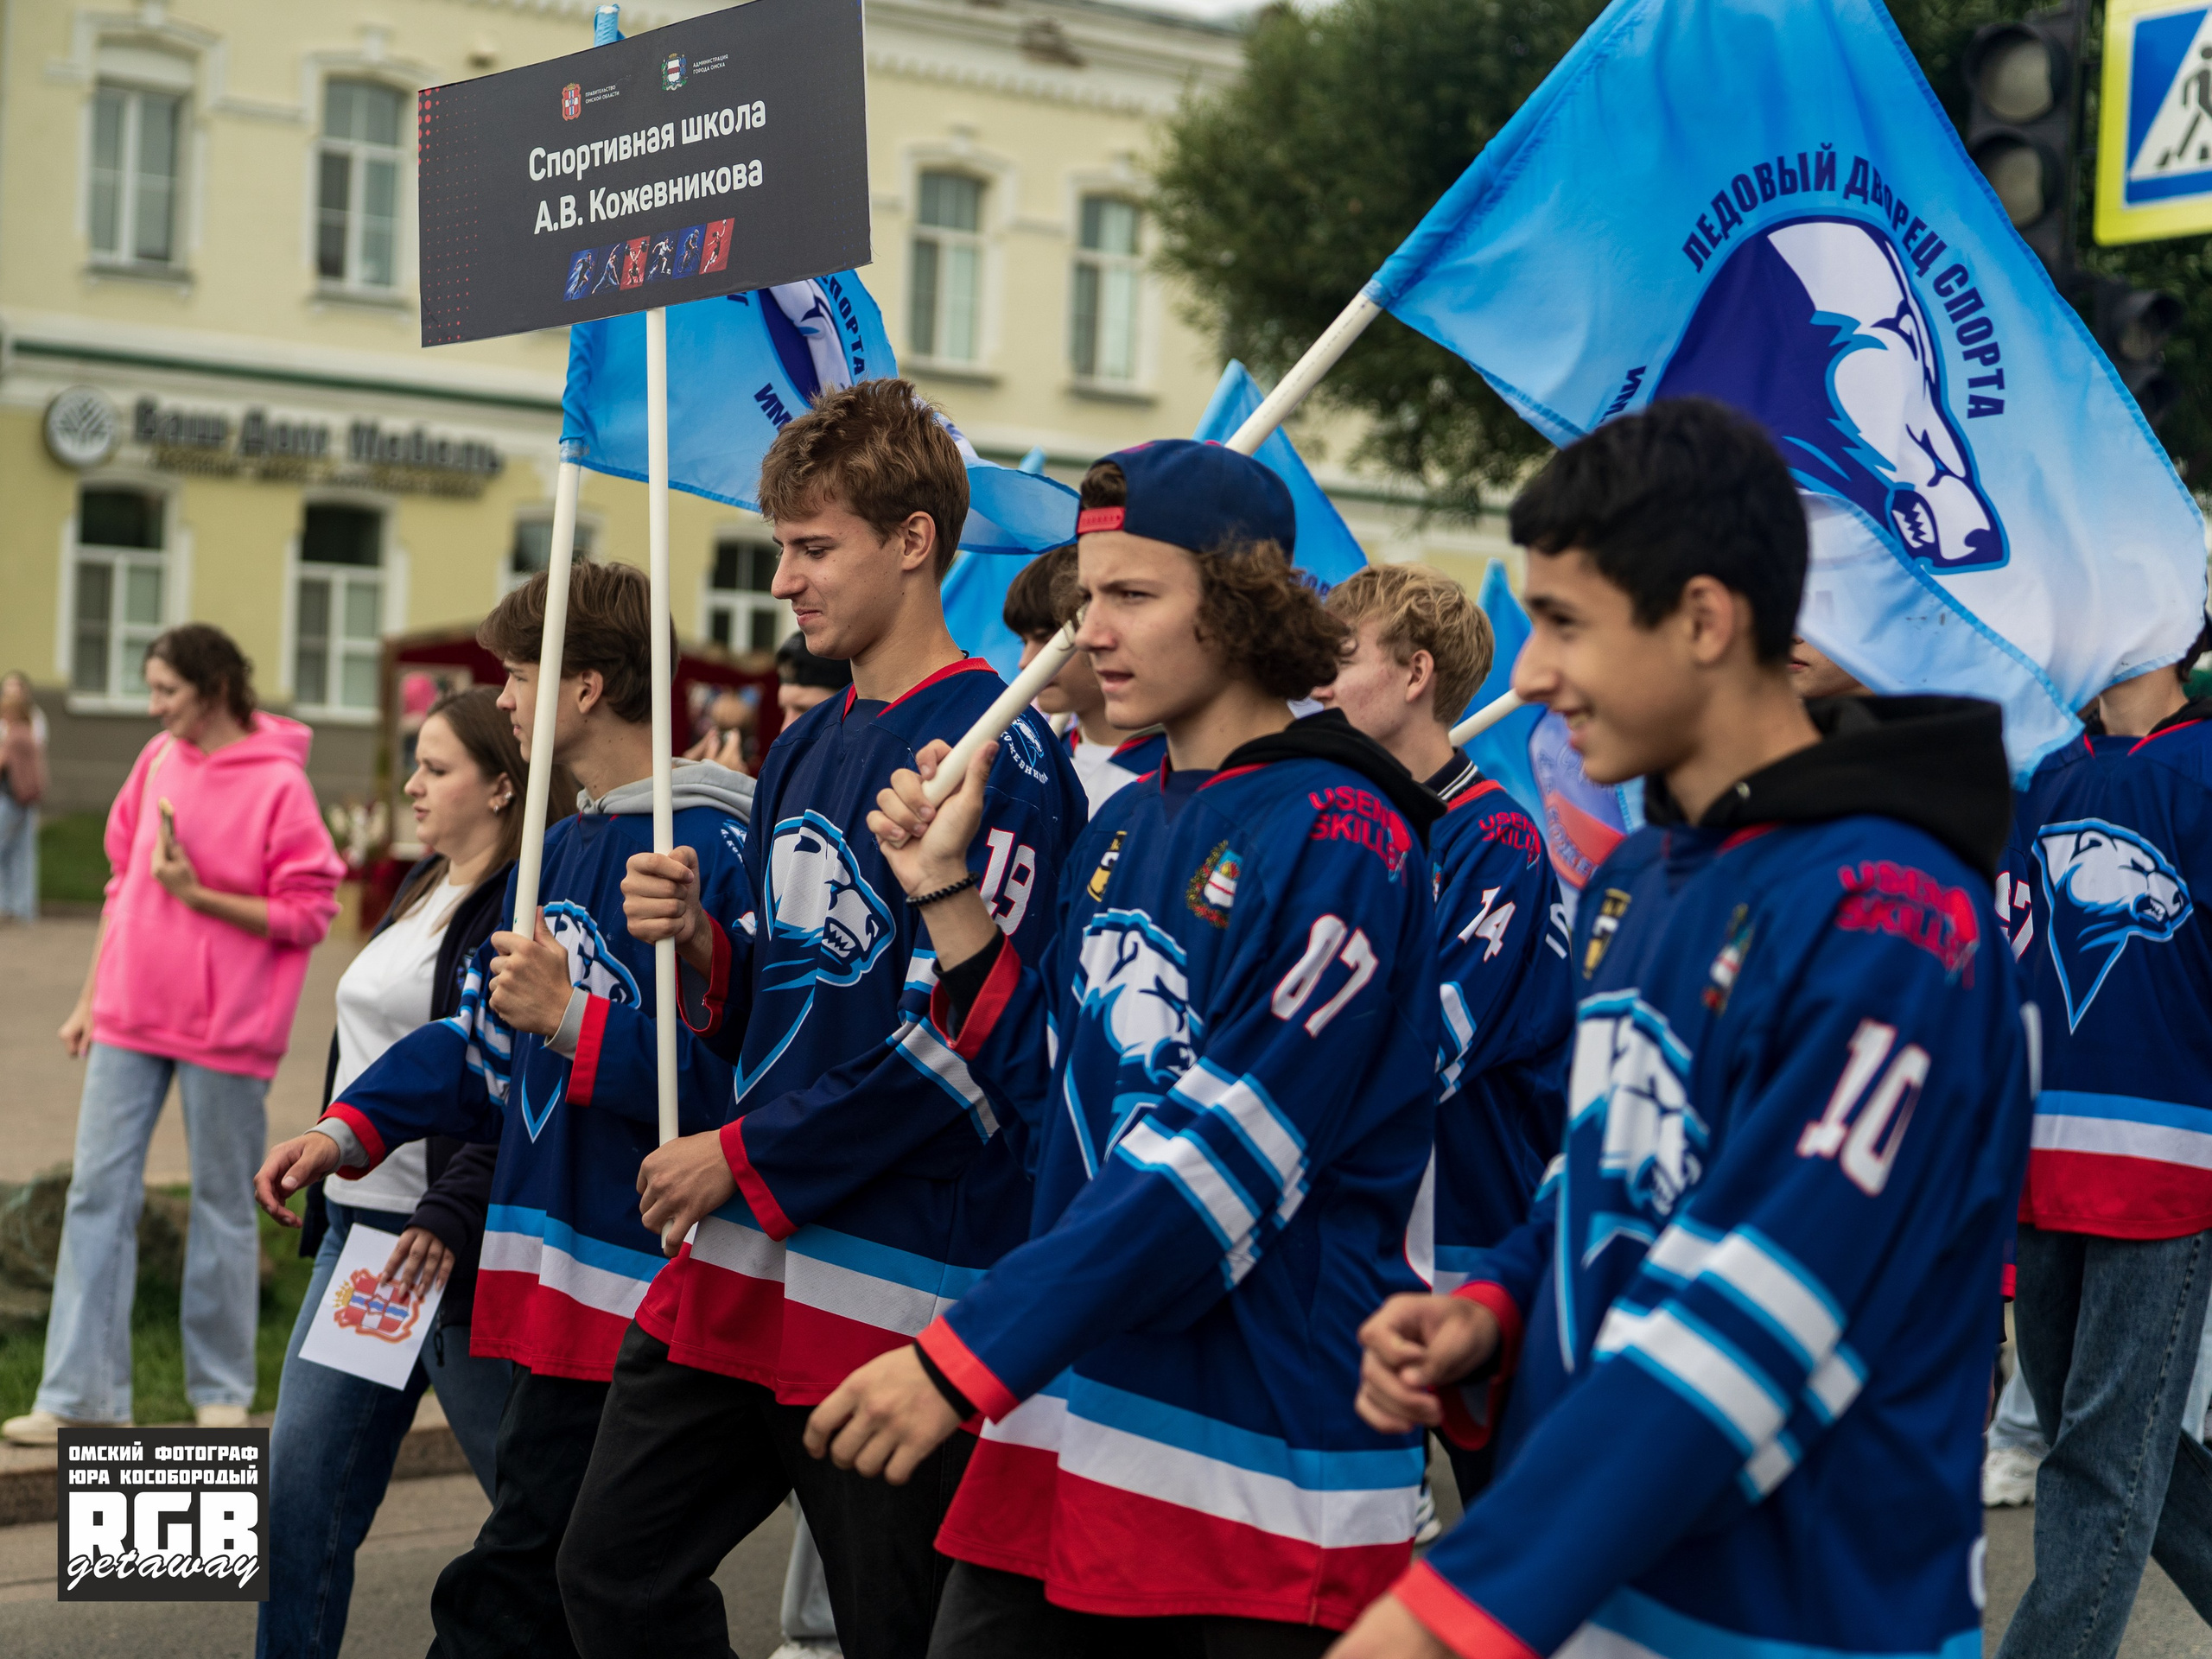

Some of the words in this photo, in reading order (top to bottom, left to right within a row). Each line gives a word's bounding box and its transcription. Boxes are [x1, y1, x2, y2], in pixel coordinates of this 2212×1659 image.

[585, 85, 616, 97] ПРАВИТЕЛЬСТВО
[585, 94, 602, 104] ОМСКОЙ
[602, 91, 620, 99] ОБЛАСТИ
[692, 54, 728, 68] АДМИНИСТРАЦИЯ
[710, 62, 726, 71] ОМСКА
[529, 122, 675, 181] Спортивная
[681, 100, 766, 145] школа
[534, 194, 583, 235] А.В.
[589, 159, 763, 223] Кожевникова
[1681, 142, 1836, 273] ЛЕДОВЫЙ
[1843, 156, 1948, 277] ДВОРЕЦ
[1933, 263, 2005, 419] СПОРТА
[980, 828, 1036, 936] 19
[1457, 886, 1516, 963] 14
[1795, 1017, 1932, 1198] 10
